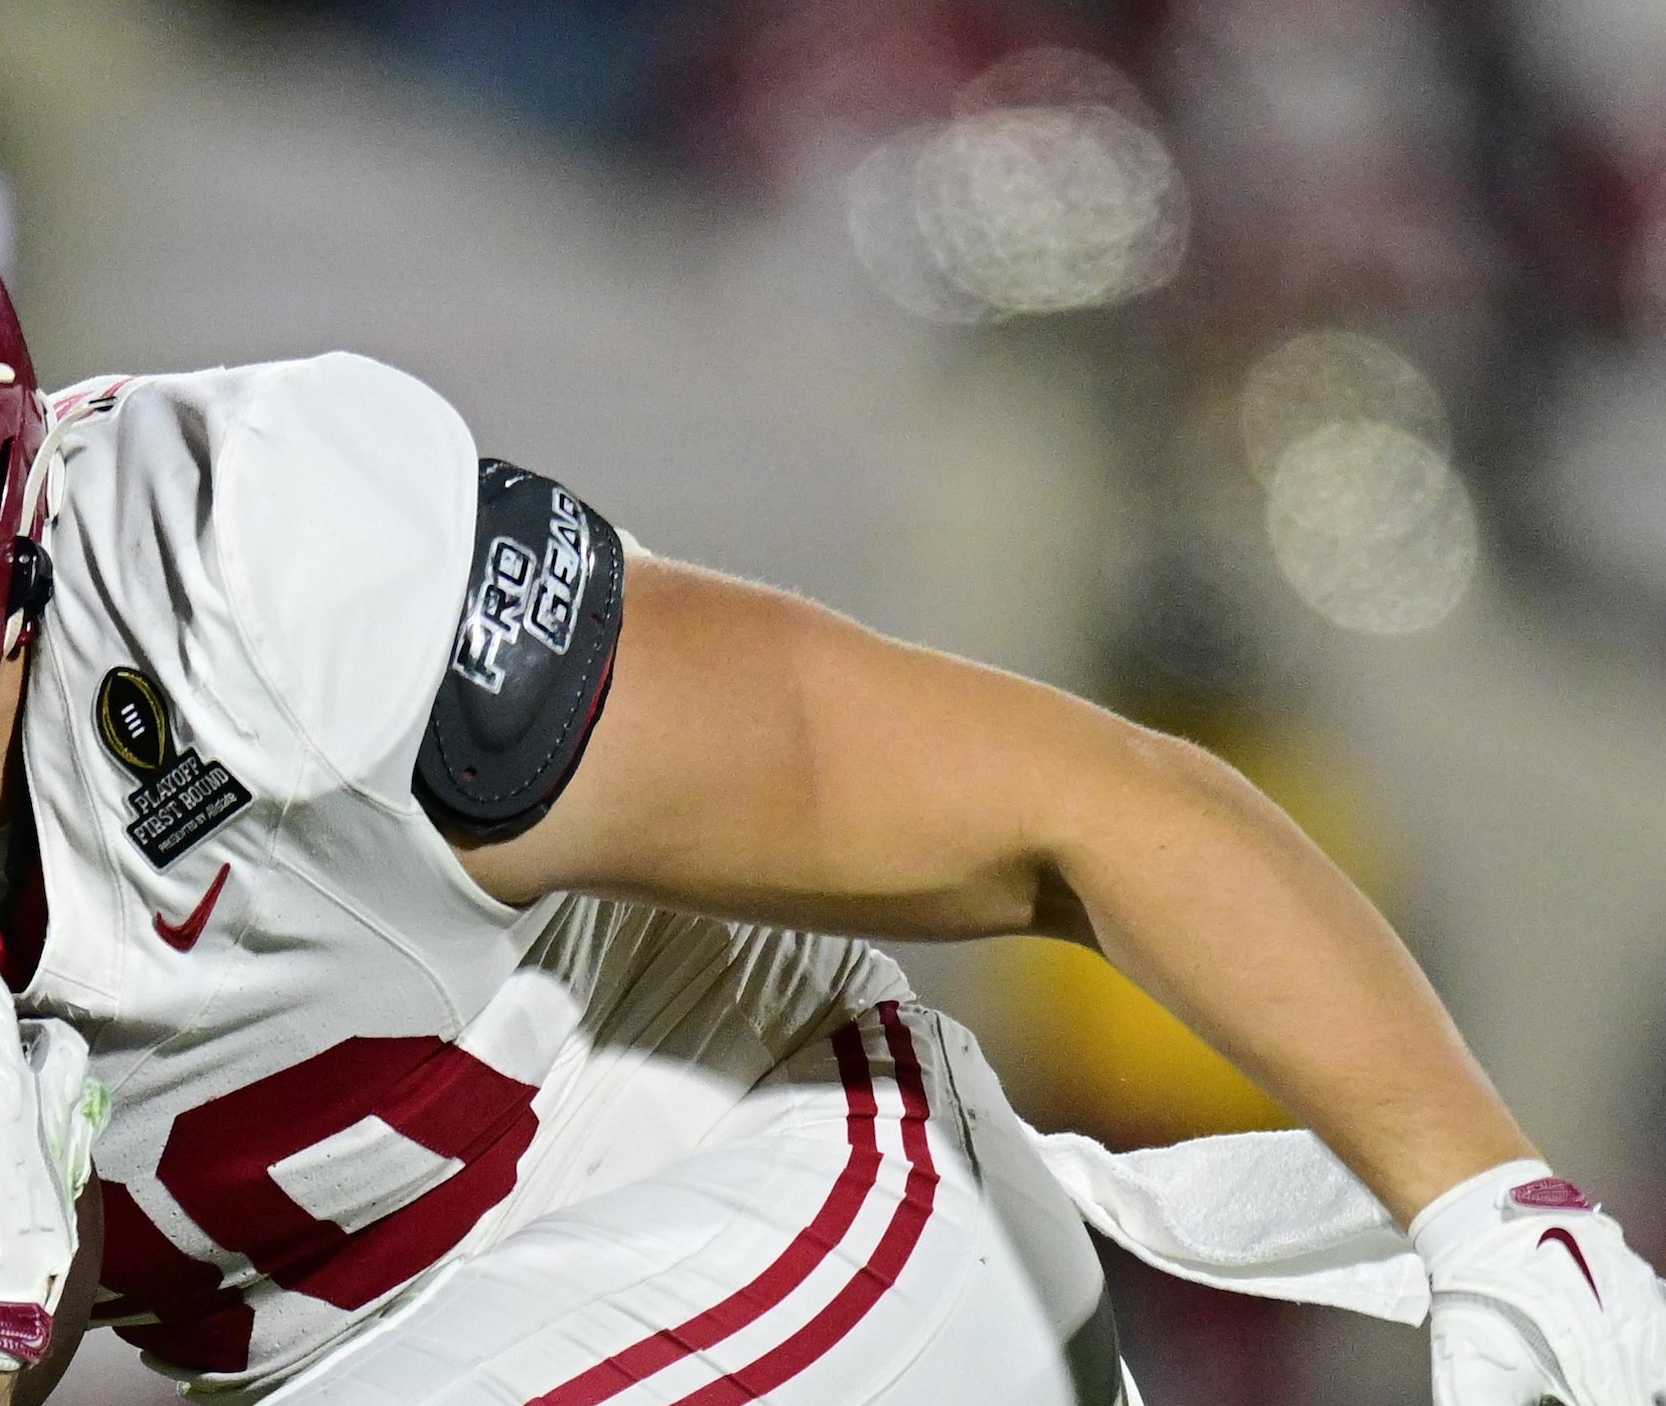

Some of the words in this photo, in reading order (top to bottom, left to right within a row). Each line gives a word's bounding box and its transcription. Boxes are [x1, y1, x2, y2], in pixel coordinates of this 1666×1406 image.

[452, 536, 538, 695] PRO
[133, 801, 183, 846] FIRST
[178, 767, 230, 811] ROUND
[134, 756, 200, 815] PLAYOFF
[194, 812, 207, 825] BY
